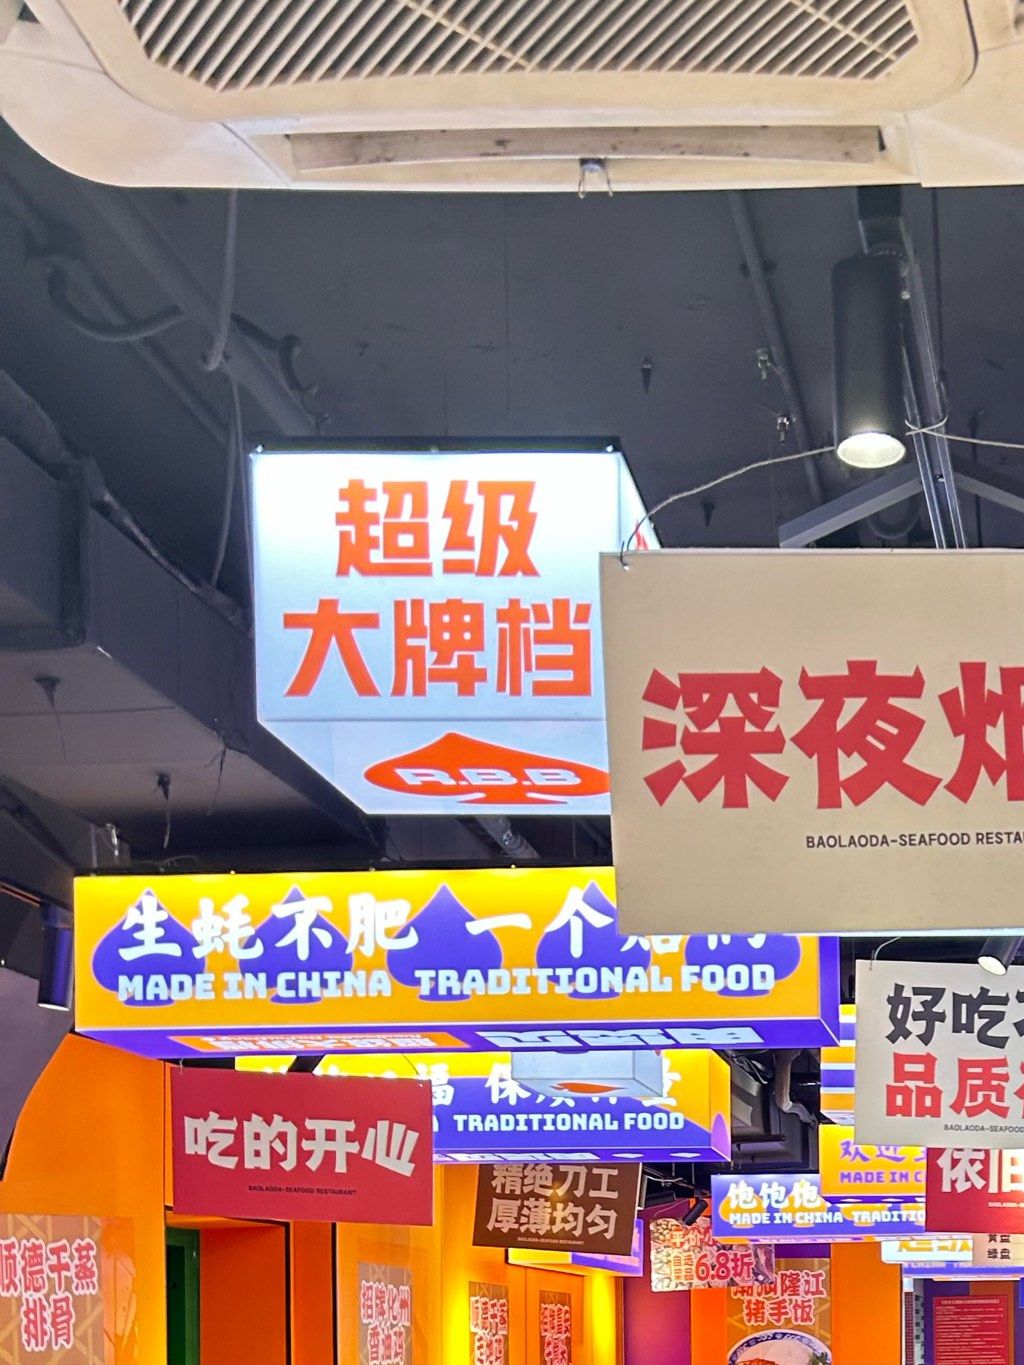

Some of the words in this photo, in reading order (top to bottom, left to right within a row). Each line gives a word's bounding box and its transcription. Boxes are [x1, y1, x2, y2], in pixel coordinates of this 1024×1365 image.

[335, 479, 541, 577] 超级
[283, 598, 593, 697] 大牌档
[805, 831, 971, 849] BAOLAODA-SEAFOOD
[118, 891, 419, 961] 生蚝不肥
[118, 972, 216, 1001] MADE
[223, 971, 267, 999] IN
[276, 969, 392, 998] CHINA
[414, 965, 674, 997] TRADITIONAL
[680, 963, 776, 992] FOOD
[453, 1113, 619, 1132] TRADITIONAL
[624, 1112, 685, 1131] FOOD
[184, 1111, 419, 1178] 吃的开心
[840, 1140, 927, 1163] 欢迎
[491, 1162, 619, 1200] 精绝刀工
[840, 1171, 885, 1183] MADE
[889, 1171, 909, 1183] IN
[486, 1197, 618, 1240] 厚薄均匀
[729, 1212, 771, 1225] MADE
[773, 1212, 792, 1224] IN
[795, 1211, 843, 1224] CHINA
[853, 1210, 926, 1223] TRADITIO
[695, 1251, 754, 1282] 6.8折
[21, 1292, 76, 1352] 排骨
[743, 1298, 816, 1326] 猪手饭
